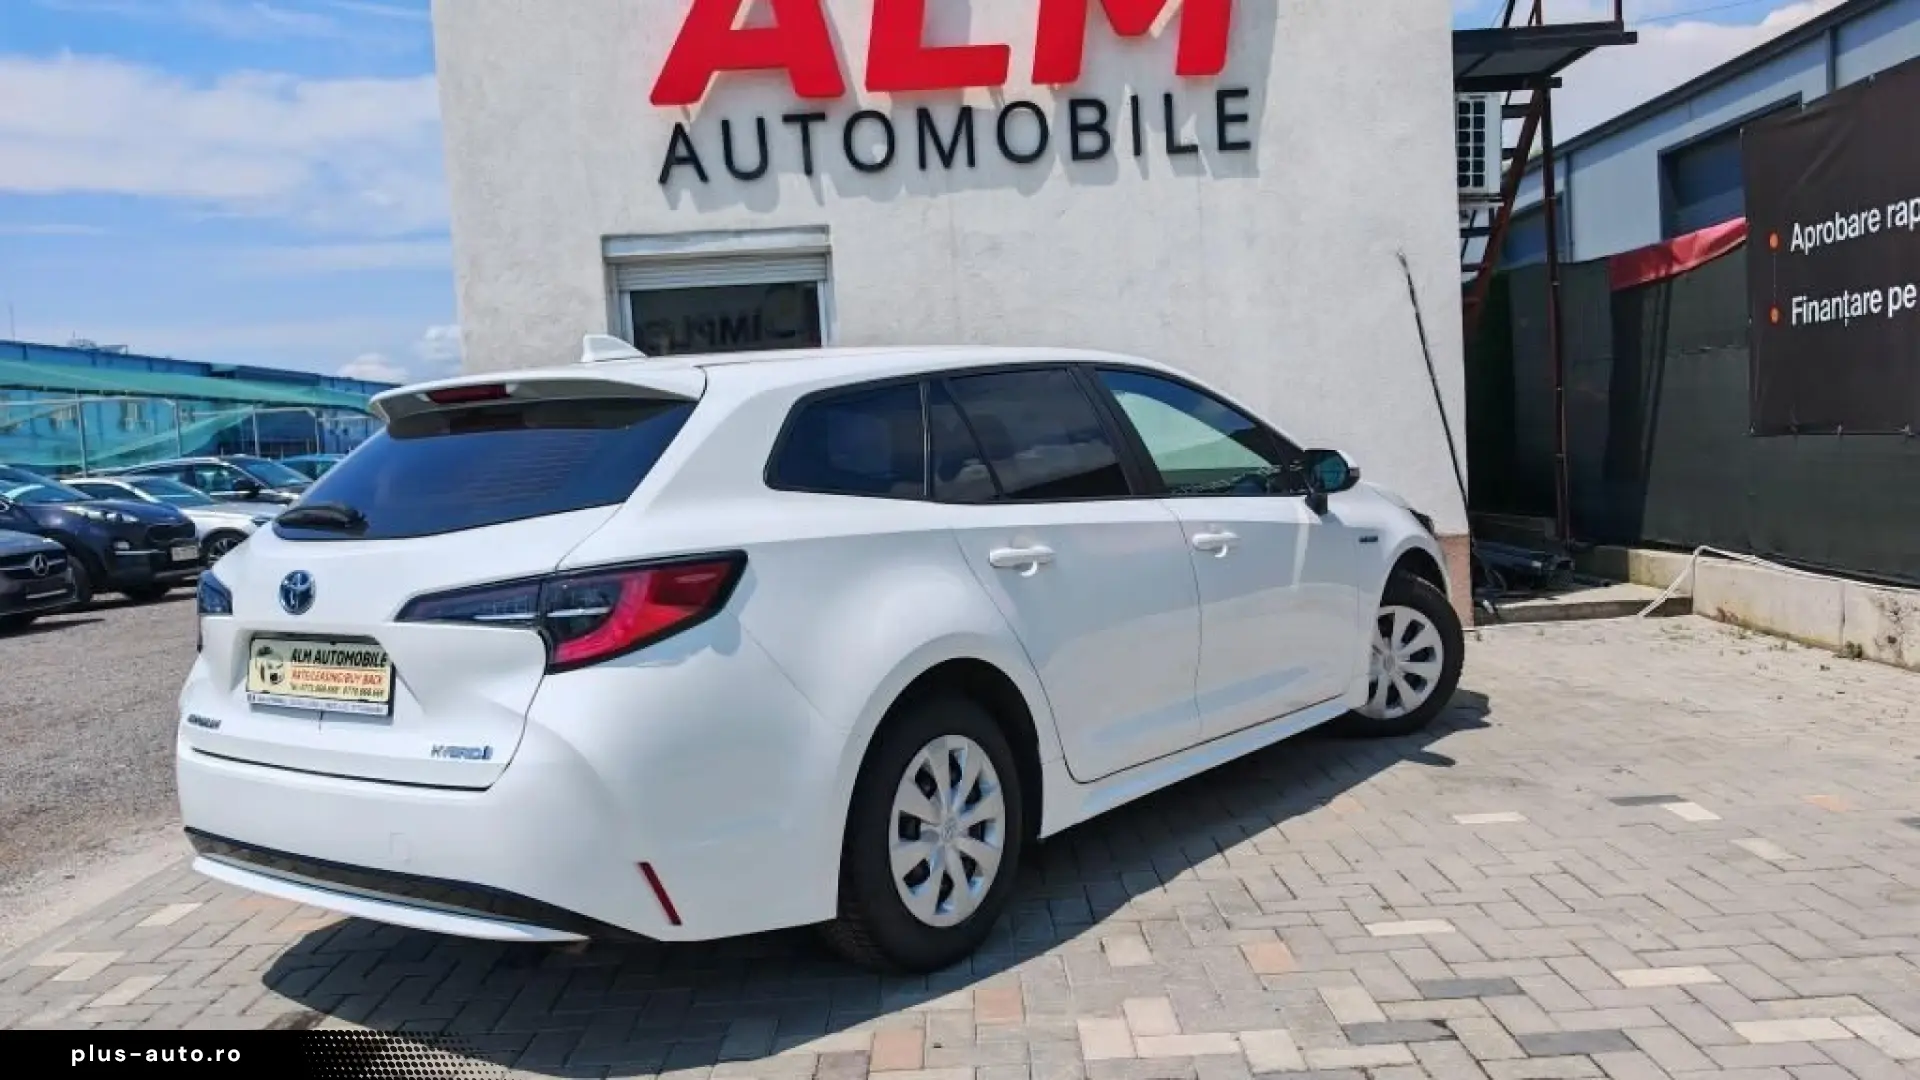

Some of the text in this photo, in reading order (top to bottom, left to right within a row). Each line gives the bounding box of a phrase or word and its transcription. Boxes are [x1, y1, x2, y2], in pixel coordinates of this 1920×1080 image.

[649, 0, 1234, 105] ALM
[658, 87, 1252, 185] AUTOMOBILE
[1790, 207, 1881, 255] Aprobare
[1791, 283, 1917, 327] Finanțare pe
[291, 648, 387, 668] ALM AUTOMOBILE
